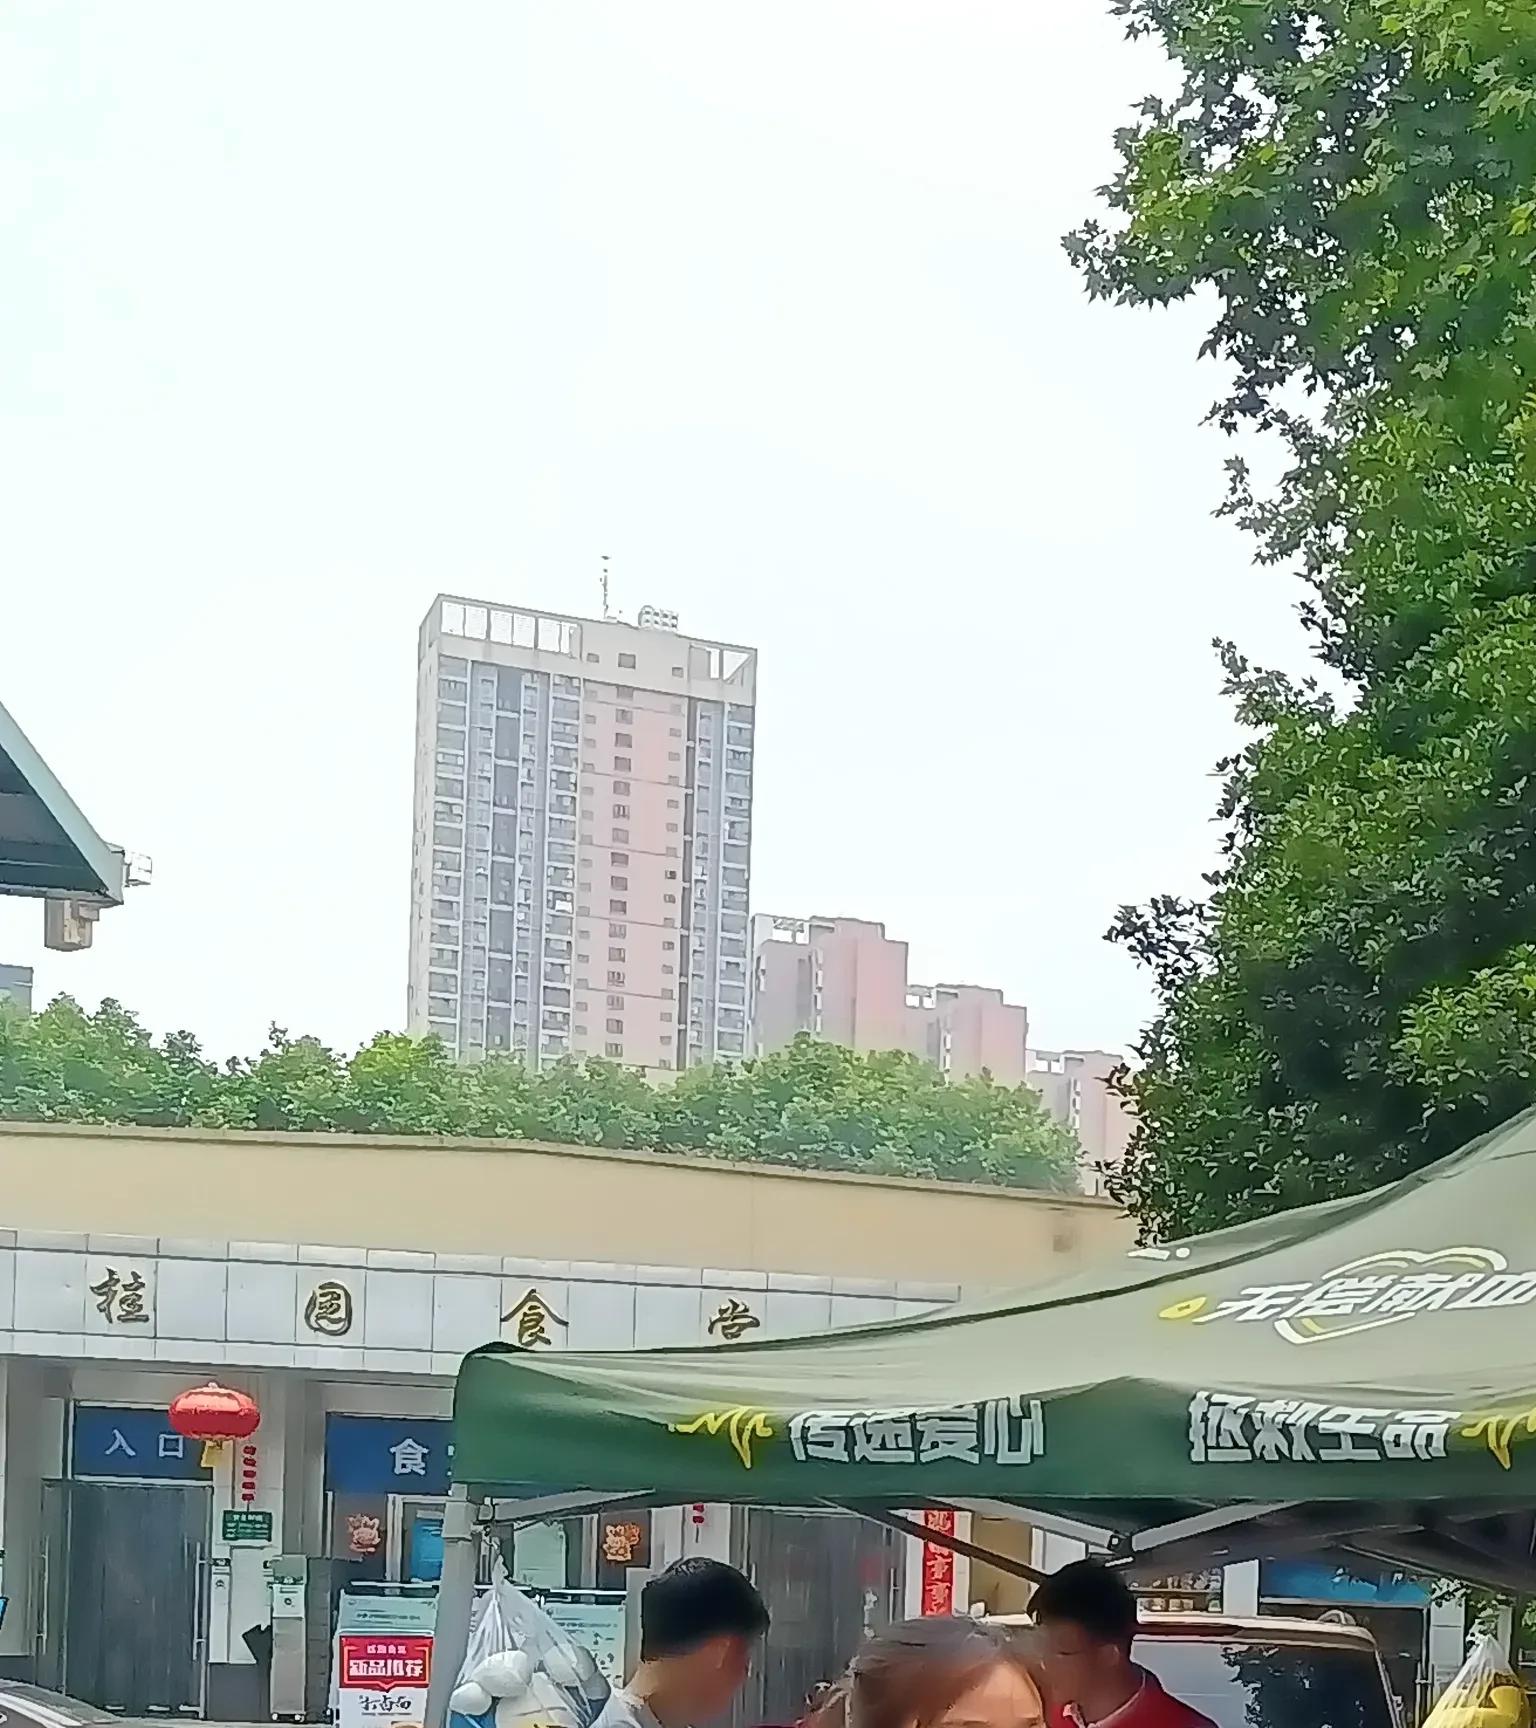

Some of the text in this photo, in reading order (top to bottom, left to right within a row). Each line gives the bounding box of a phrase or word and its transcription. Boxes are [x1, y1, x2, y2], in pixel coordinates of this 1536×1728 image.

[105, 1429, 185, 1459] 入口
[789, 1396, 1044, 1464] 传递爱心
[1189, 1391, 1461, 1462] 拯救生命
